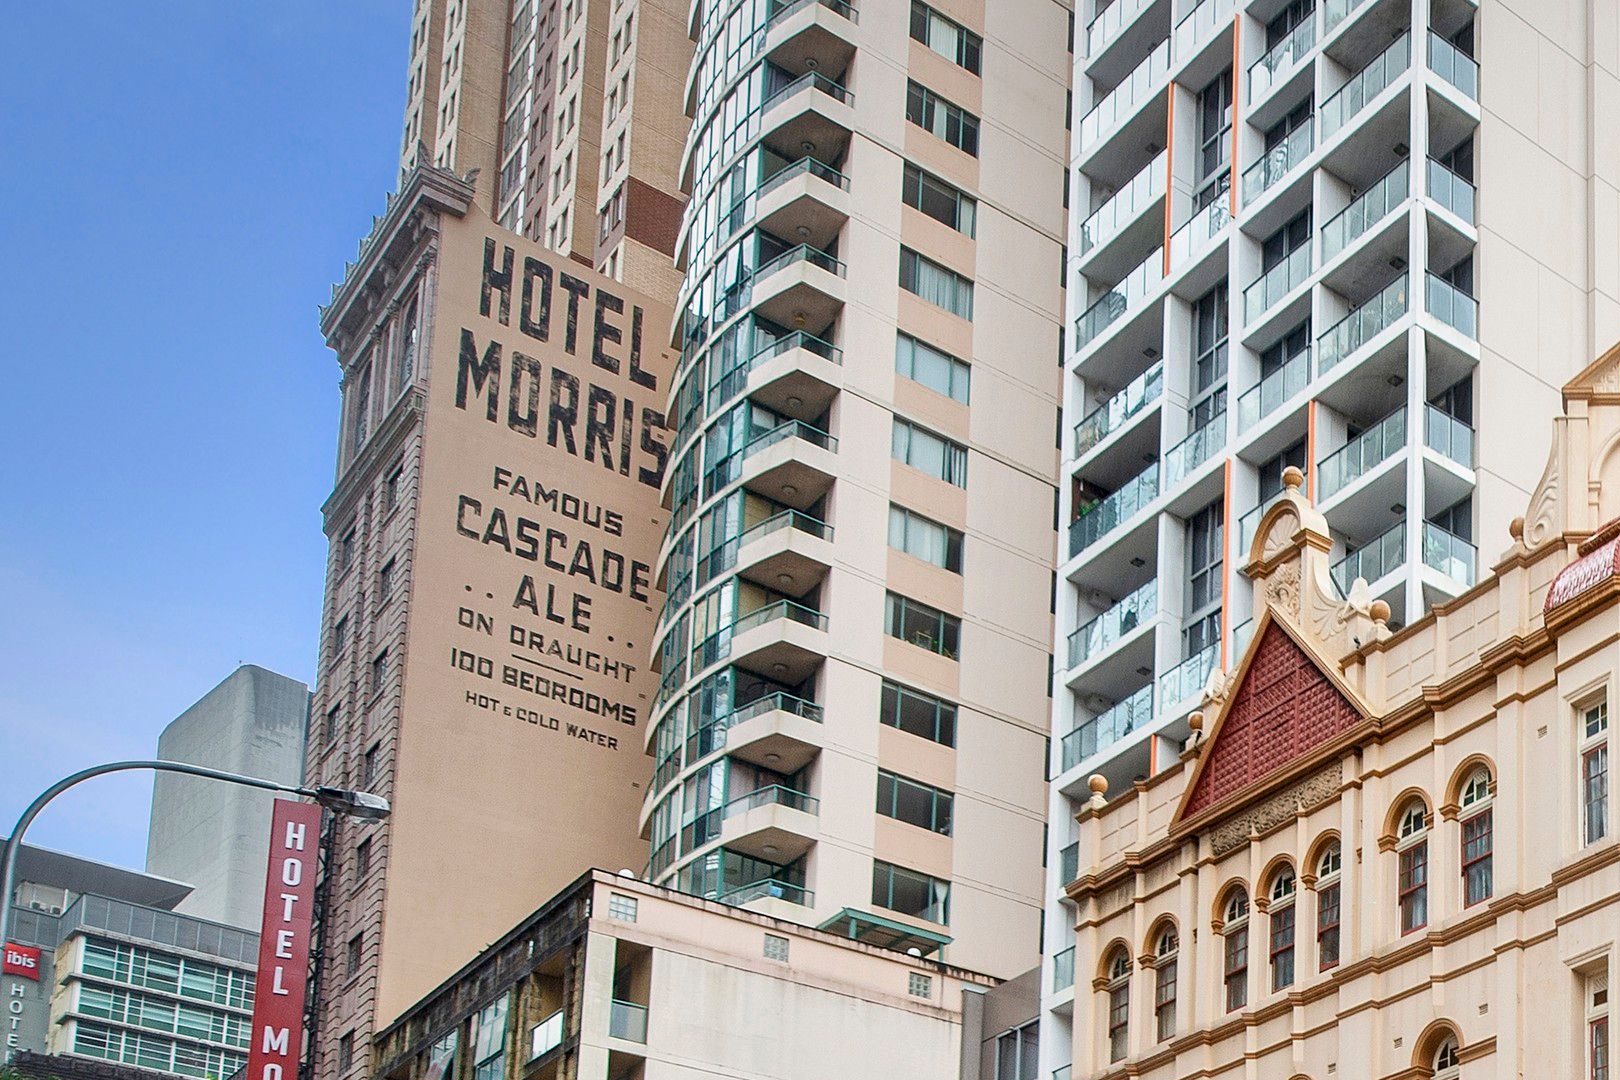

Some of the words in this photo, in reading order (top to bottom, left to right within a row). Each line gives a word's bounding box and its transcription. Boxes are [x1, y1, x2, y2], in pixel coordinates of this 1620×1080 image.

[479, 236, 657, 391] HOTEL
[455, 327, 670, 490] MORRIS
[493, 465, 624, 538] FAMOUS
[456, 495, 651, 602] CASCADE
[513, 575, 592, 634] ALE
[457, 607, 493, 636] ON
[510, 624, 637, 684] DRAUGHT
[451, 647, 493, 679] 100
[501, 664, 637, 726] BEDROOMS
[465, 690, 499, 712] HOT
[516, 707, 560, 732] COLD
[565, 722, 619, 751] WATER
[272, 820, 306, 997] HOTEL
[6, 950, 36, 968] ibis
